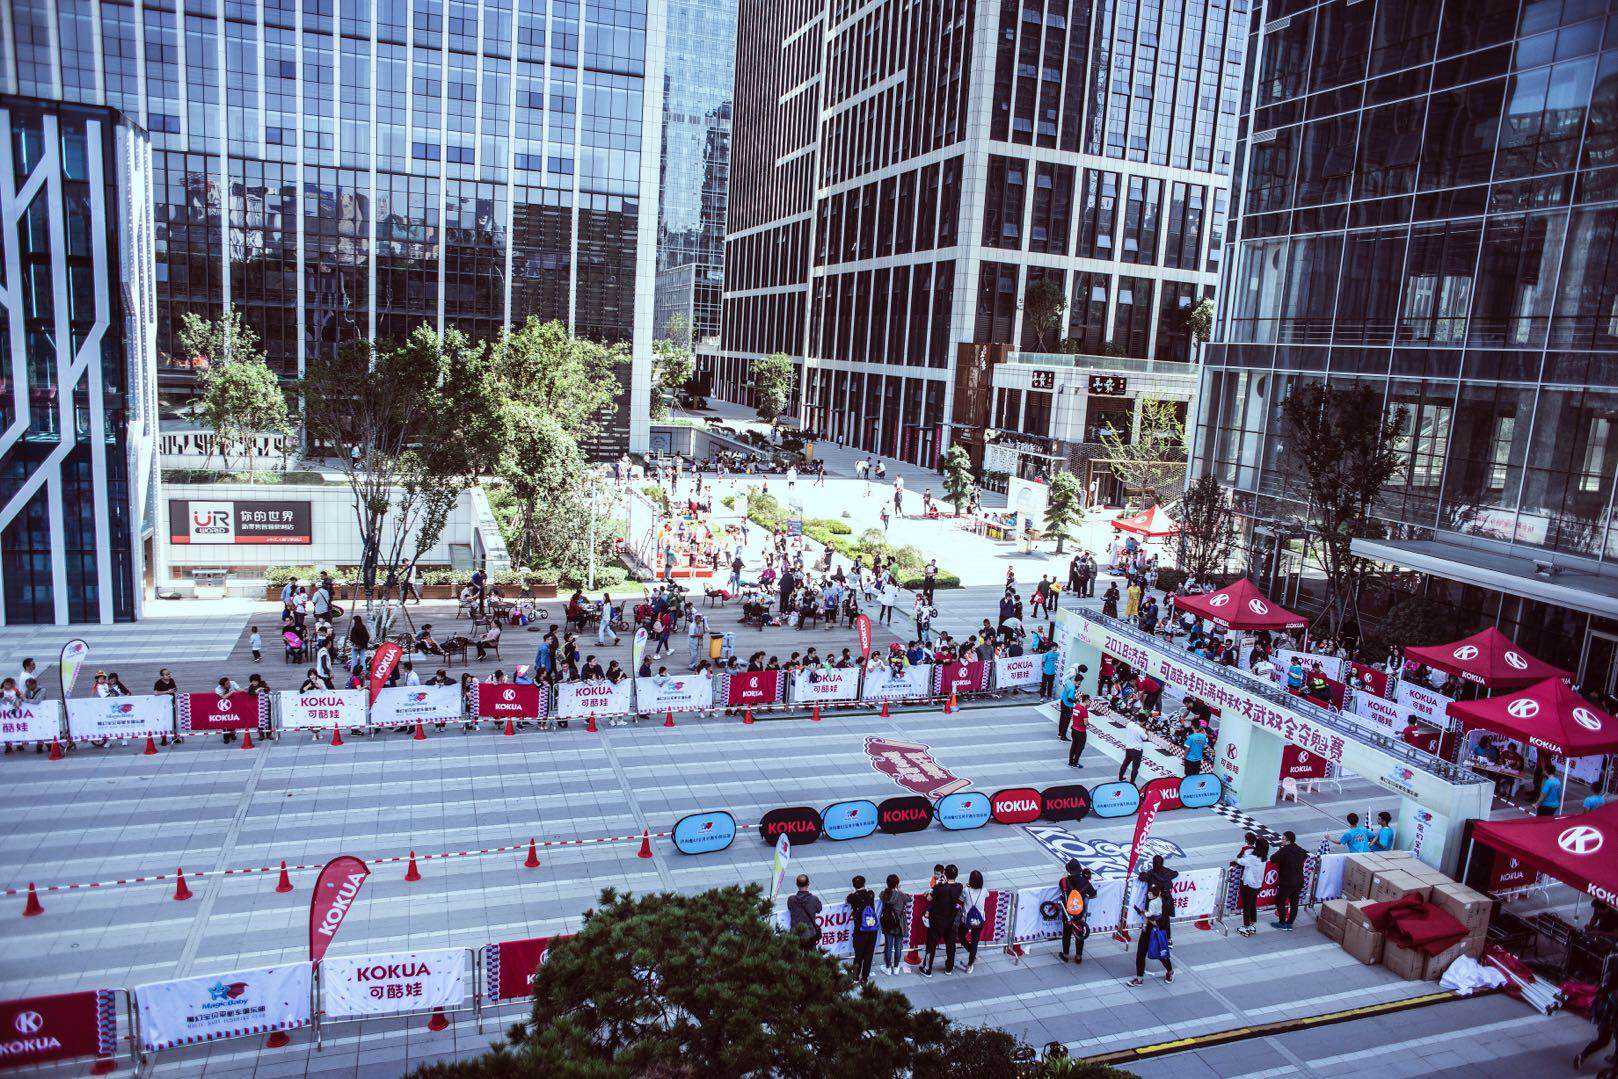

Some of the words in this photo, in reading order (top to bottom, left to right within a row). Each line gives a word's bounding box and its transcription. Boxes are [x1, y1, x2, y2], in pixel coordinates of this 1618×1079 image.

[374, 649, 398, 679] KOKUA
[1007, 661, 1033, 671] KOKUA
[1461, 671, 1486, 685] KOKUA
[576, 686, 613, 697] KOKUA
[1409, 689, 1438, 707] KOKUA
[300, 697, 345, 707] KOKUA
[495, 703, 522, 711] KOKUA
[1367, 700, 1398, 718] KOKUA
[209, 713, 240, 722] KOKUA
[308, 709, 340, 719] 可酷娃
[1529, 736, 1562, 754] KOKUA
[1290, 765, 1313, 773] KOKUA
[995, 799, 1039, 813] KOKUA
[1046, 796, 1087, 811] KOKUA
[883, 809, 928, 823] KOKUA
[768, 819, 816, 834] KOKUA
[318, 872, 366, 936] KOKUA
[357, 962, 431, 982] KOKUA
[370, 982, 423, 999] 可酷娃
